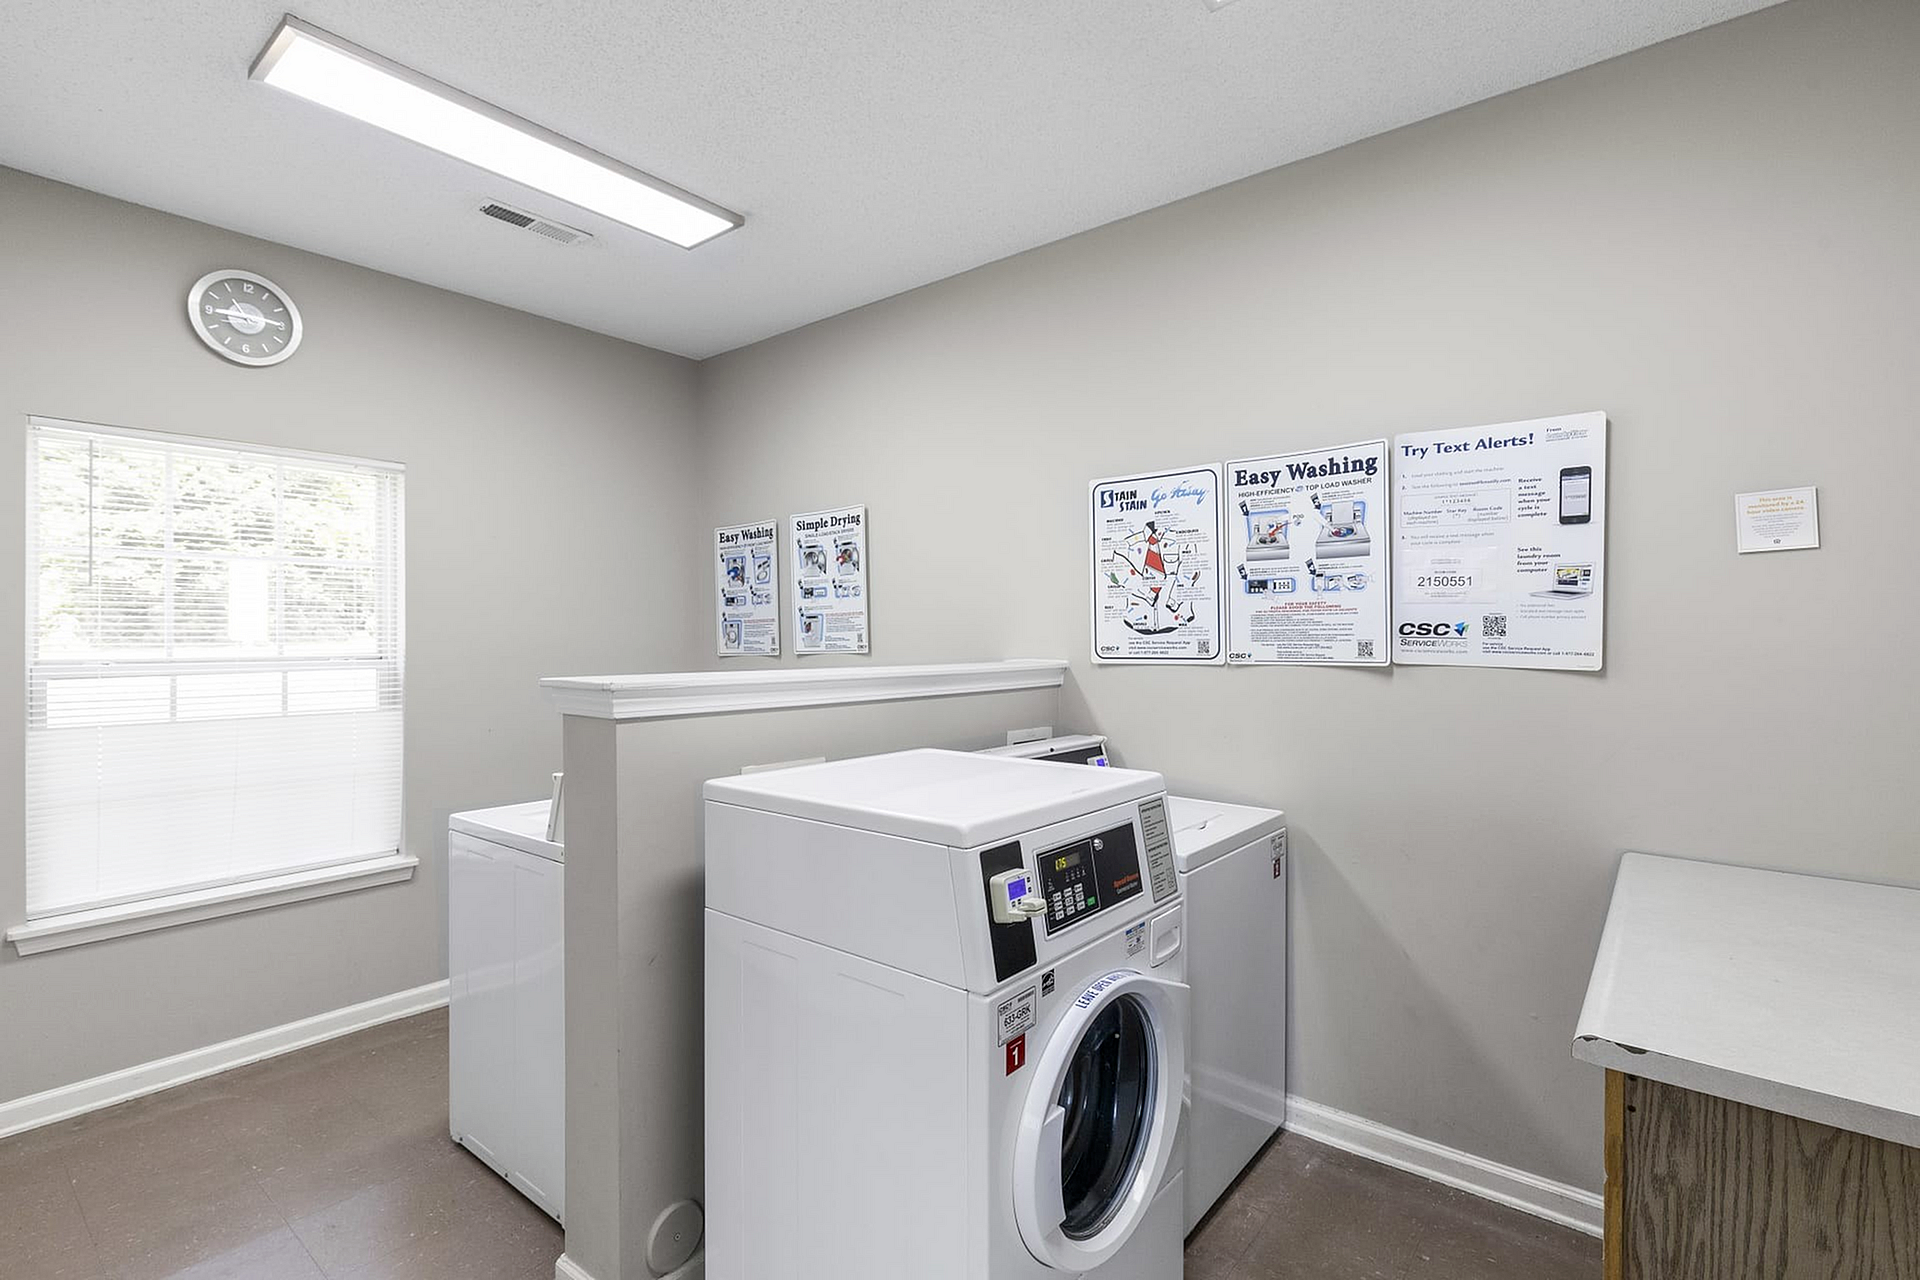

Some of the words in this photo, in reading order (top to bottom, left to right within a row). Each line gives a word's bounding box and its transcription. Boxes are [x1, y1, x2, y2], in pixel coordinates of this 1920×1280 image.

[243, 282, 254, 294] 12
[204, 305, 213, 314] 9
[277, 321, 286, 331] 3
[242, 344, 250, 354] 6
[1401, 445, 1428, 459] Try
[1433, 442, 1470, 454] Text
[1475, 432, 1534, 450] Alerts!
[1234, 468, 1282, 488] Easy
[1286, 456, 1378, 480] Washing
[1238, 487, 1296, 498] HIGH-EFFICIENCY
[1320, 482, 1340, 490] LOAD
[1341, 478, 1372, 487] WASHER
[1119, 500, 1148, 513] STAIN
[796, 518, 828, 532] Simple
[830, 514, 861, 528] Drying
[719, 532, 740, 544] Easy
[741, 527, 774, 541] Washing
[1417, 575, 1472, 586] 2150551
[1398, 622, 1452, 636] CSC
[1075, 990, 1099, 1009] LEAVE
[1004, 1004, 1031, 1027] 633-GRK
[1012, 1046, 1018, 1066] 1
